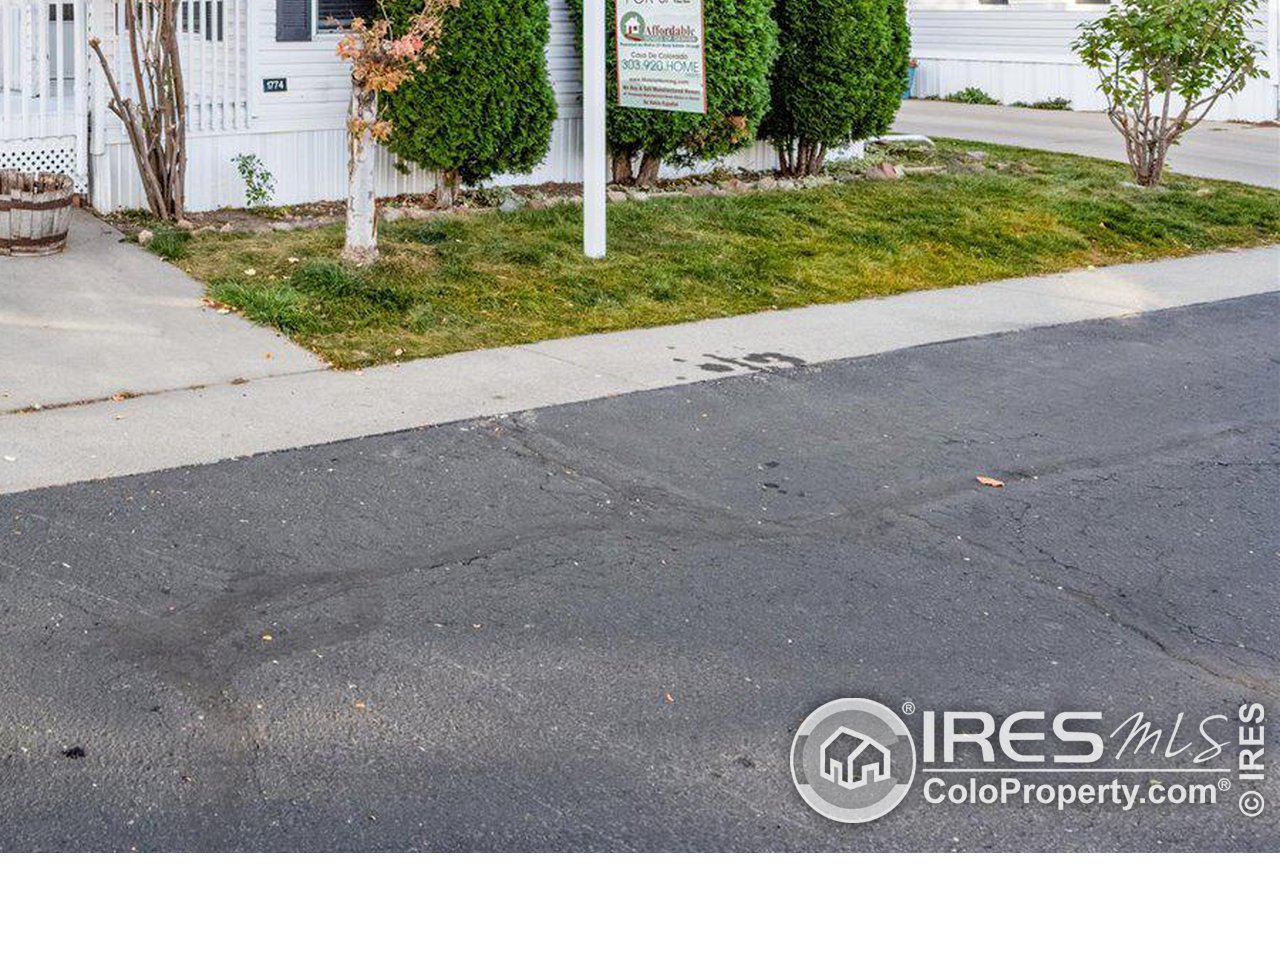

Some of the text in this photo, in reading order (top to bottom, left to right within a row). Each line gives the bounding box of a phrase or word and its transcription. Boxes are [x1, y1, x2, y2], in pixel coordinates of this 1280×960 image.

[646, 25, 696, 36] Affordable
[631, 51, 689, 60] Casa De Colorado
